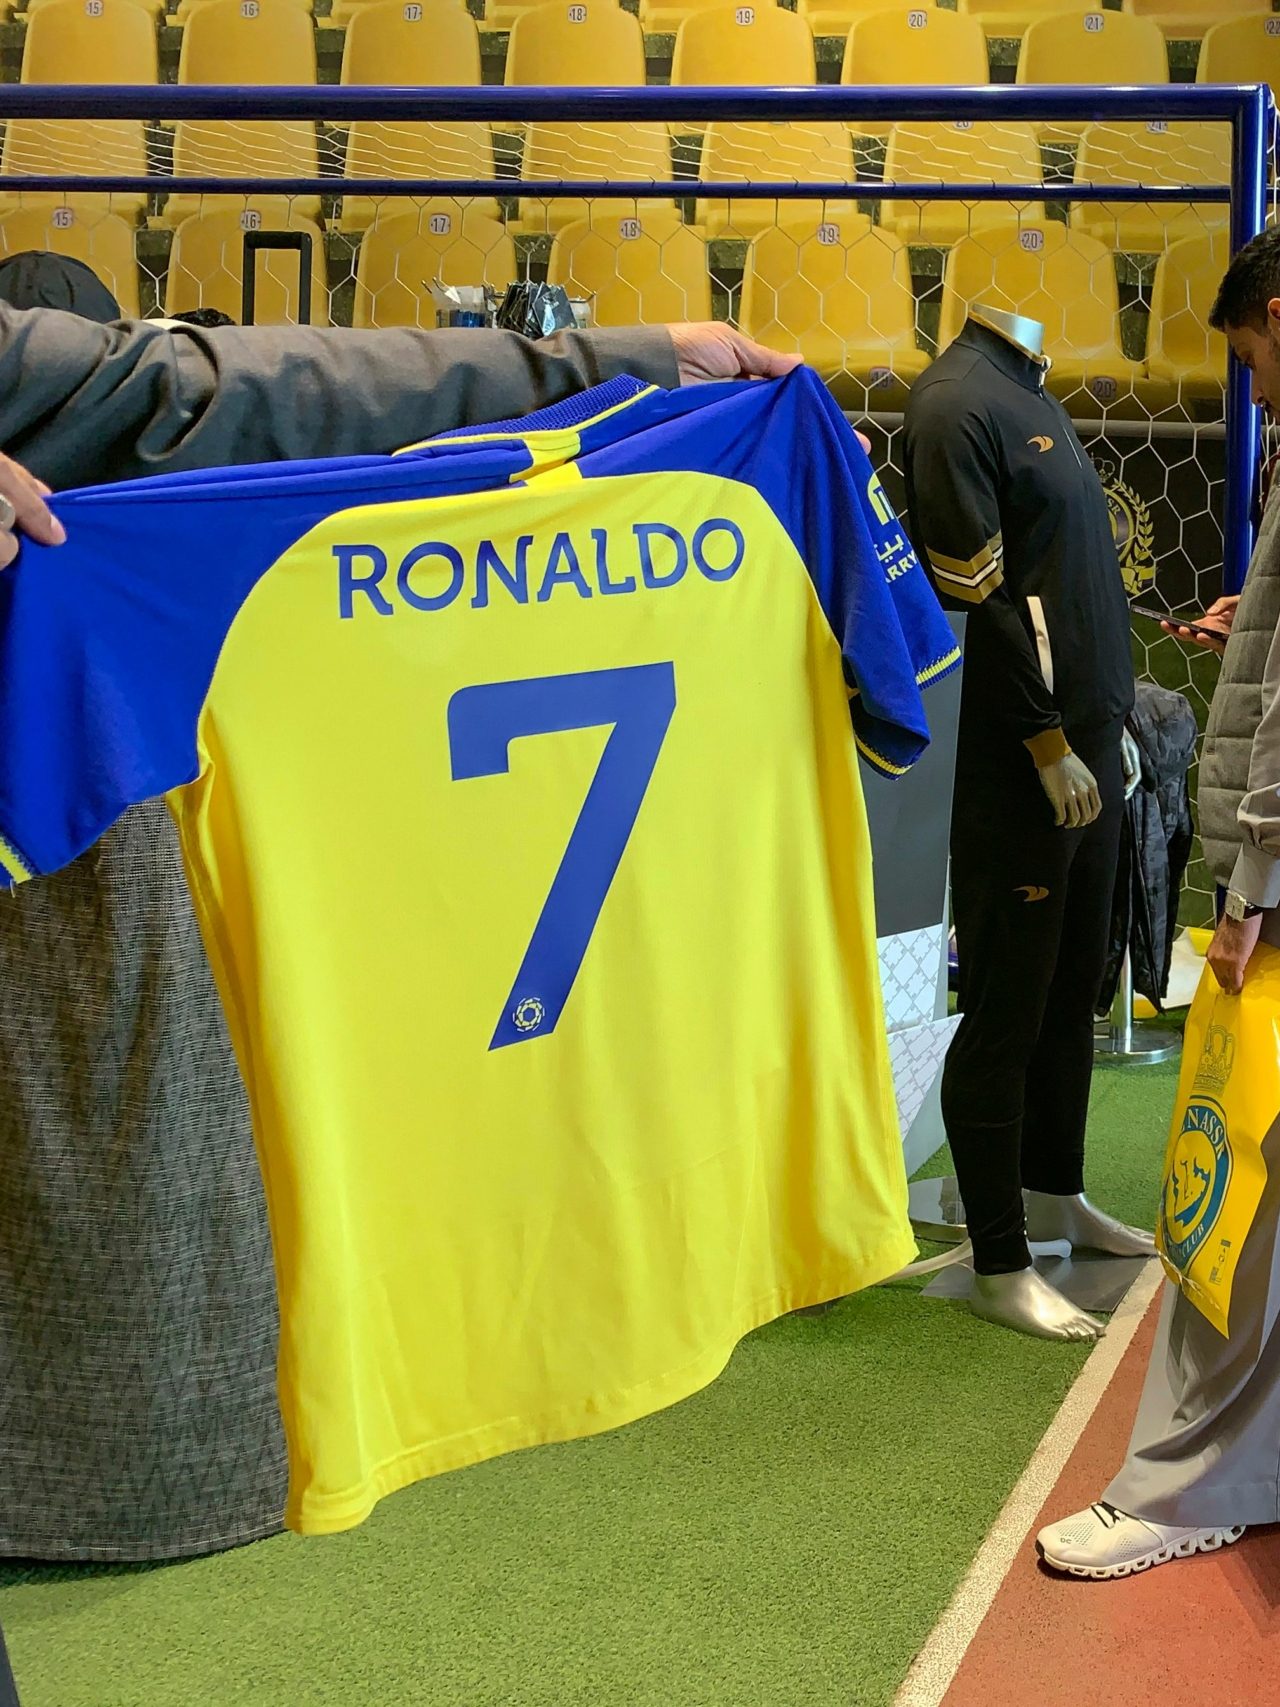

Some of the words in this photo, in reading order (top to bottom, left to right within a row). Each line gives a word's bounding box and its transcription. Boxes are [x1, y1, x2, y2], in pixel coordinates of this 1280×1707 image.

[88, 1, 99, 15] 15
[243, 3, 255, 16] 16
[406, 6, 419, 20] 17
[571, 7, 583, 21] 18
[739, 10, 751, 24] 19
[910, 14, 923, 28] 20
[1087, 17, 1099, 31] 21
[55, 211, 69, 226] 15
[244, 214, 257, 229] 16
[433, 217, 447, 233] 17
[623, 222, 637, 238] 18
[822, 227, 836, 243] 19
[1023, 233, 1038, 250] 20
[1096, 380, 1112, 398] 20
[331, 518, 745, 619] RONALDO
[885, 549, 918, 583] RRY
[447, 661, 677, 1051] 7
